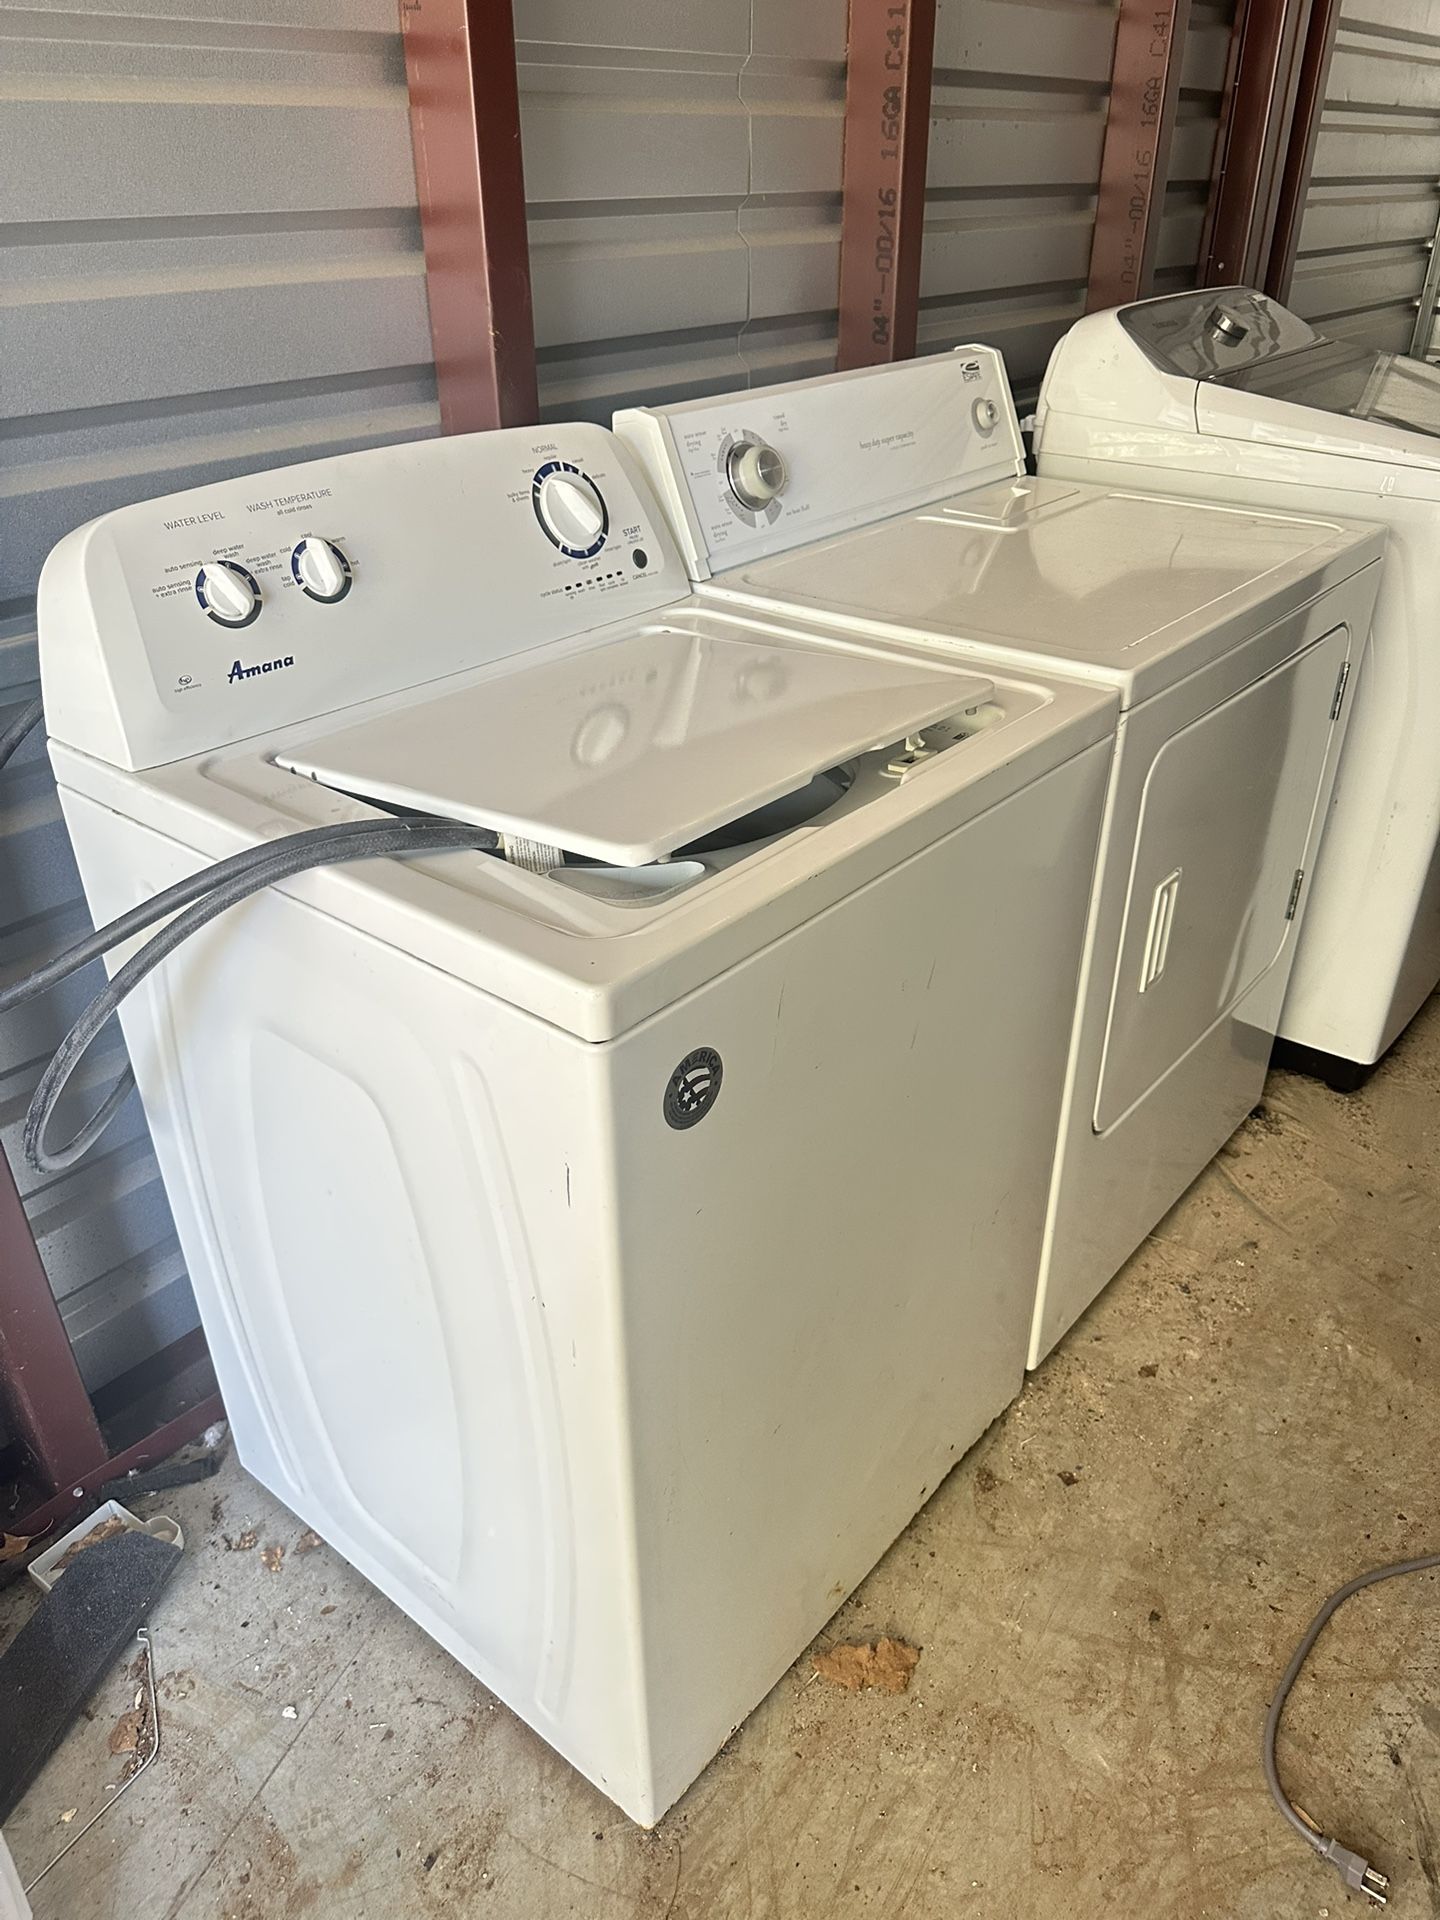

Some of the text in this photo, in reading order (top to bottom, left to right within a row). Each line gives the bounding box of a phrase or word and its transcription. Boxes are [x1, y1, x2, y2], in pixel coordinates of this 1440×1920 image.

[884, 3, 907, 70] C41
[1149, 11, 1172, 57] C41
[1140, 76, 1162, 128] 16GA
[880, 85, 902, 159] 16GA
[532, 443, 558, 454] NORMAL
[246, 488, 333, 513] WASH TEMPERATURE
[284, 507, 297, 515] cold
[296, 503, 313, 512] rinses
[163, 511, 226, 531] WATER LEVEL
[622, 525, 642, 537] START
[212, 543, 244, 557] deep water
[224, 551, 239, 559] wash
[280, 546, 292, 554] cold
[245, 552, 276, 564] deep water
[256, 560, 271, 568] wash
[164, 560, 203, 574] auto sensing
[254, 566, 269, 575] extra
[268, 563, 283, 571] rinse
[152, 578, 192, 595] auto sensing
[160, 588, 178, 599] extra
[177, 584, 193, 595] rinse
[283, 581, 296, 589] cold
[227, 655, 295, 685] Amana
[672, 1050, 721, 1087] AMERICA
